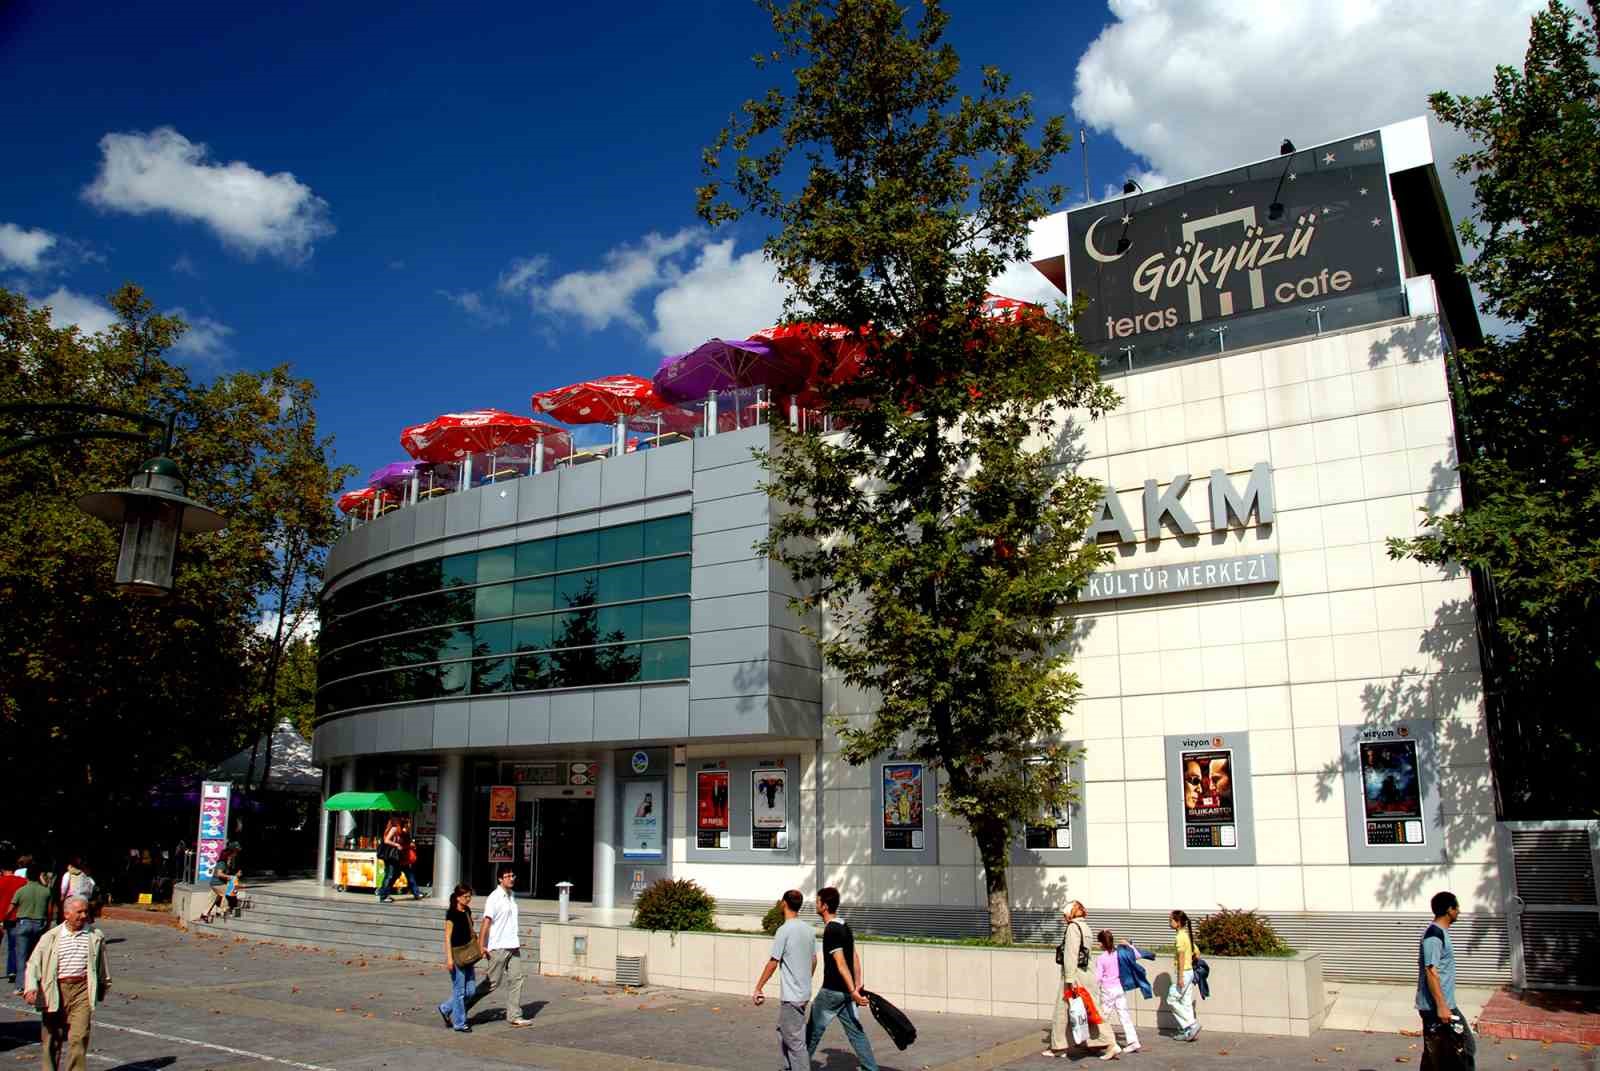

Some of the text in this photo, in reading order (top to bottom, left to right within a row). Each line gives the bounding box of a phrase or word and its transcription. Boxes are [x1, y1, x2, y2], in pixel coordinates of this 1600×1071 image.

[1132, 213, 1315, 301] Gökyüzü
[1274, 268, 1353, 304] cafe
[1105, 306, 1179, 340] teras
[1086, 461, 1274, 546] AKM
[1089, 555, 1268, 598] KÜLTÜR MERKEZİ
[1182, 737, 1210, 749] vizyon
[1364, 728, 1394, 739] vizyon
